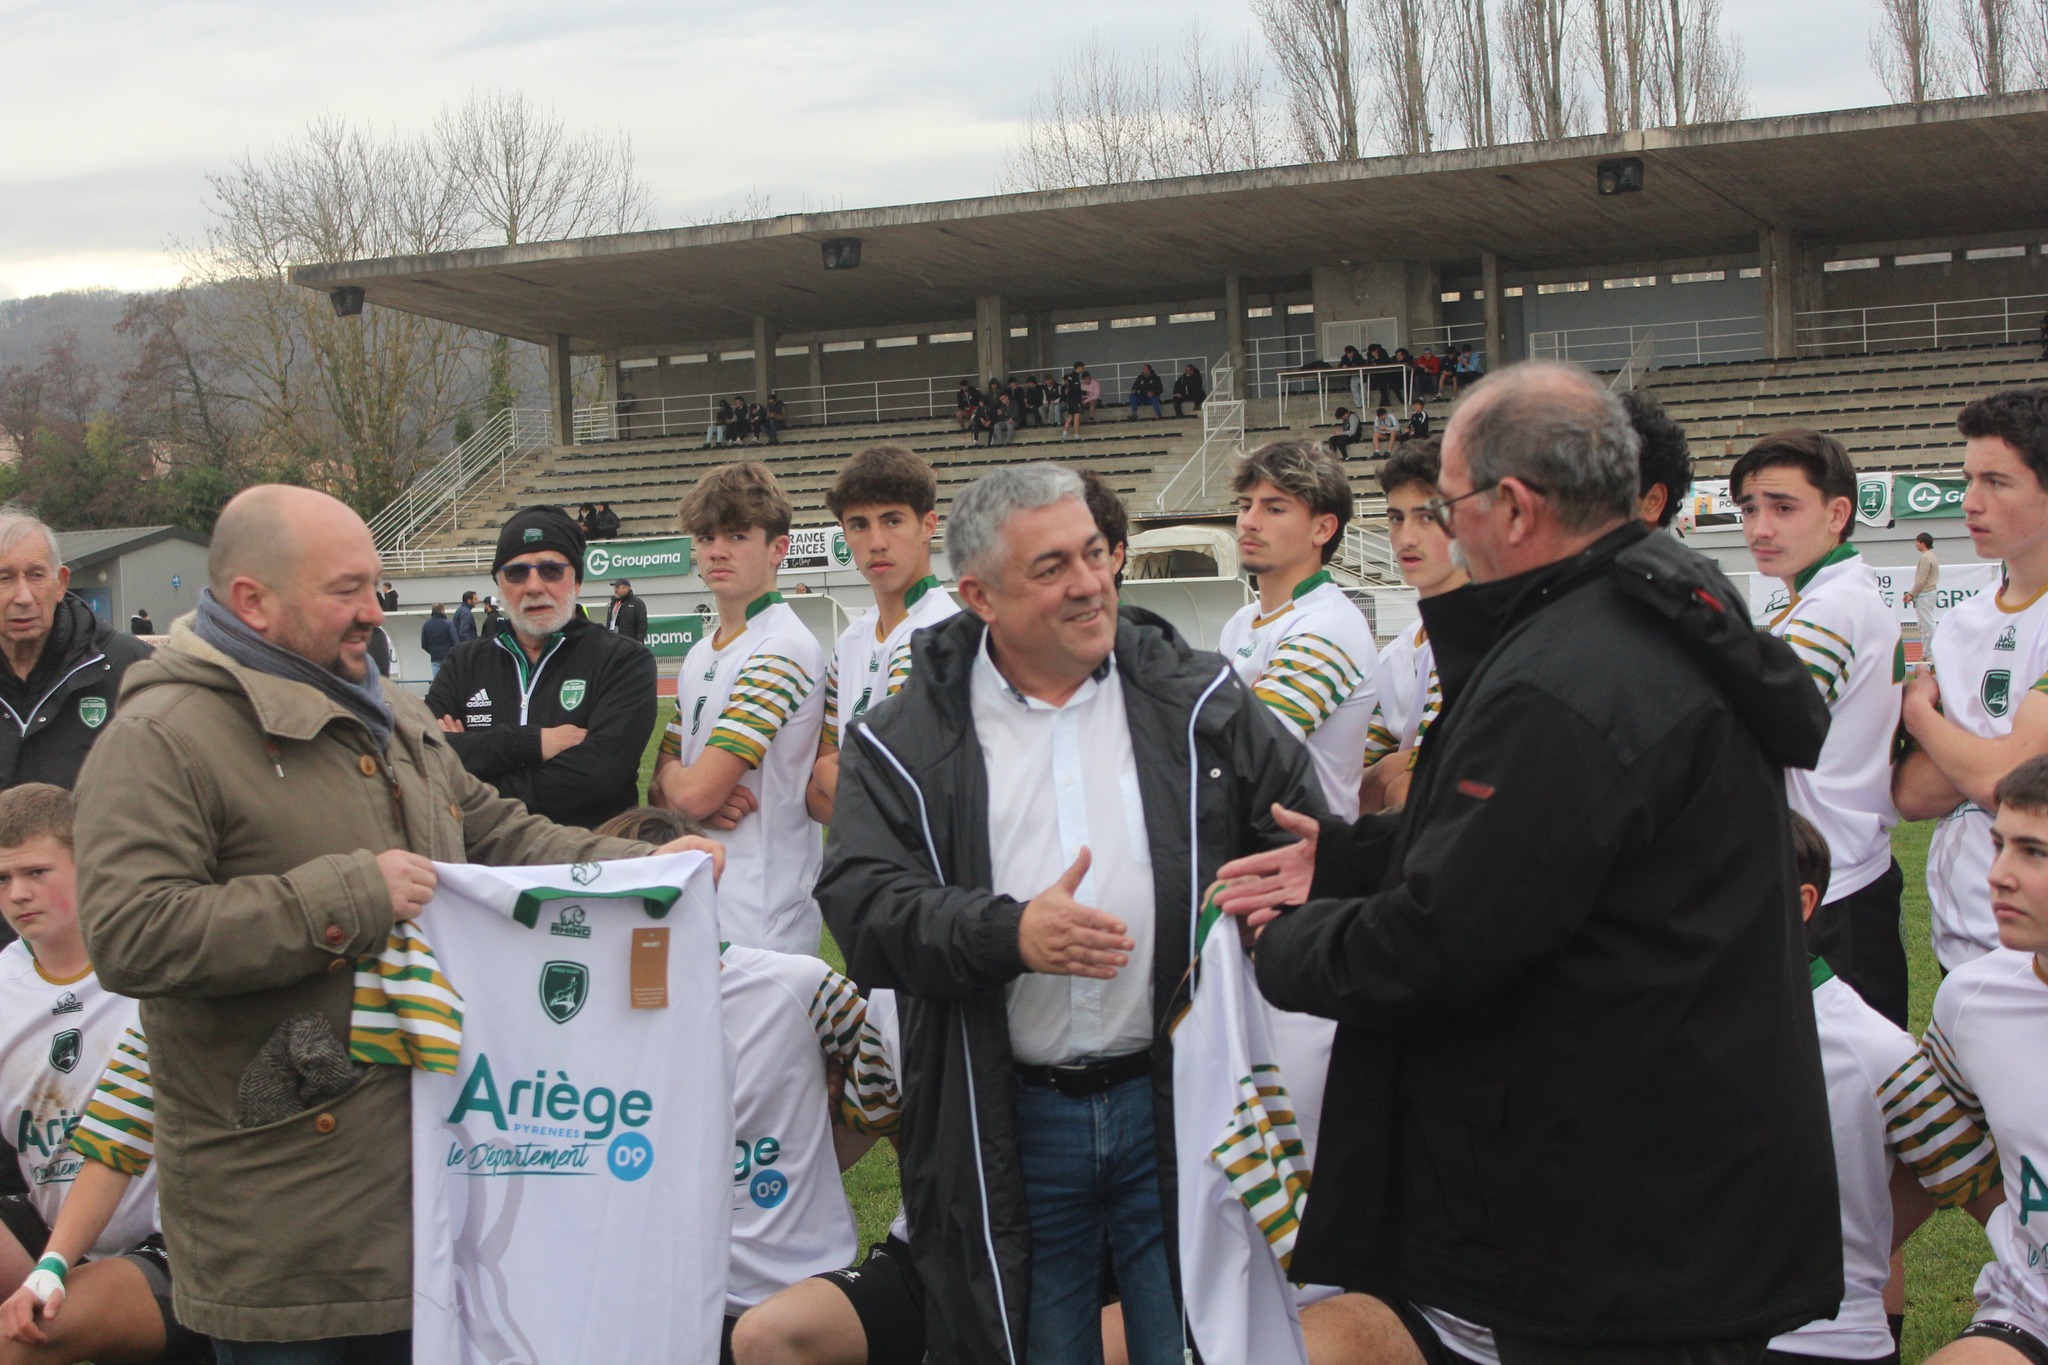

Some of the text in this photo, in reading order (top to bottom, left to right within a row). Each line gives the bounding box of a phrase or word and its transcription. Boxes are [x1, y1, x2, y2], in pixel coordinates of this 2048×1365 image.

[786, 543, 826, 556] ENCES
[611, 552, 681, 569] Groupama
[644, 631, 692, 647] upama
[466, 700, 492, 708] adidas
[550, 924, 591, 938] RHINO
[447, 1052, 653, 1140] Ariège
[513, 1123, 580, 1139] PYRENEES
[447, 1141, 466, 1167] le
[614, 1145, 647, 1168] 09
[756, 1180, 782, 1198] 09
